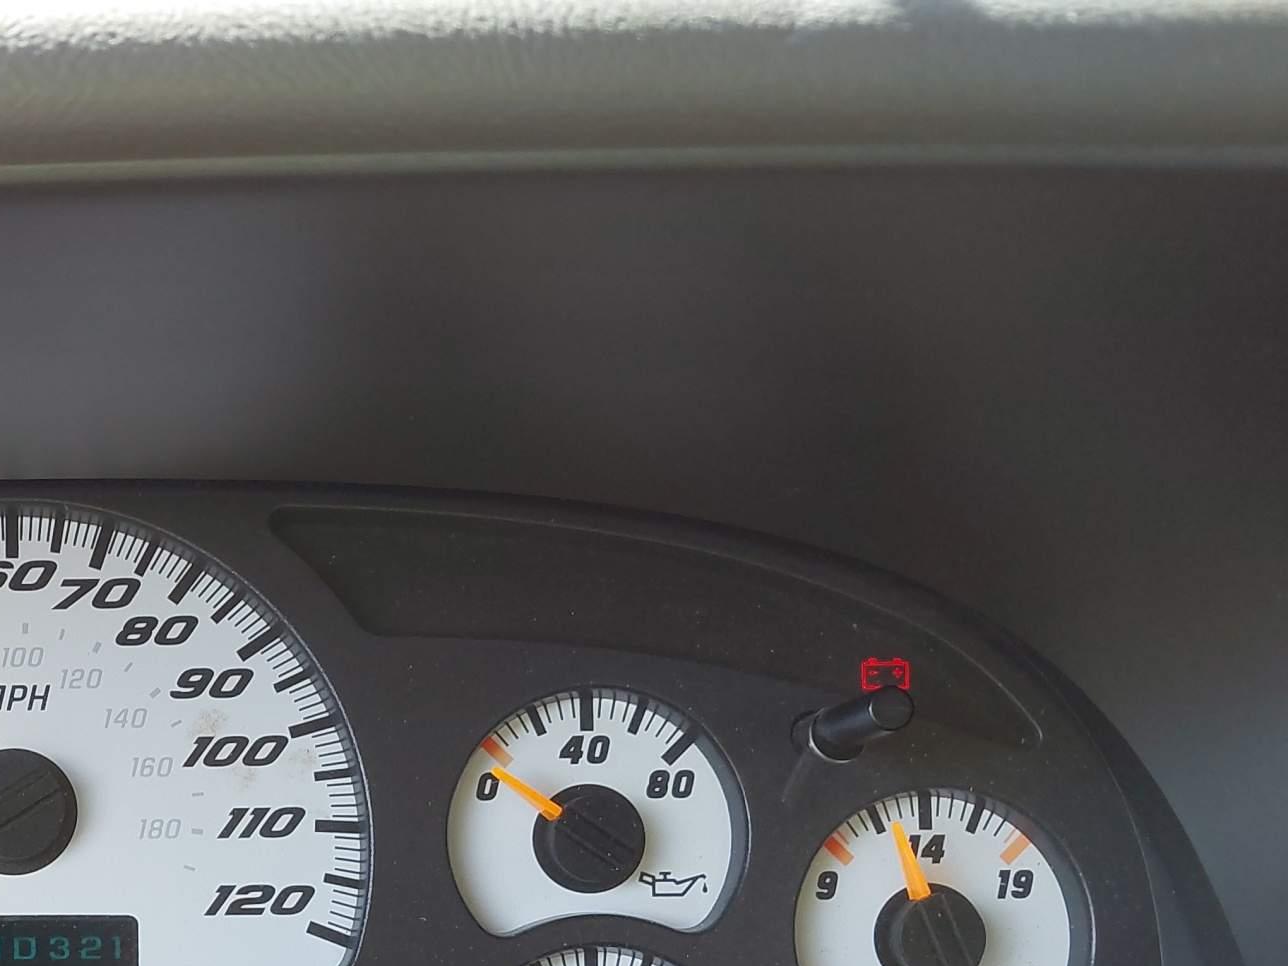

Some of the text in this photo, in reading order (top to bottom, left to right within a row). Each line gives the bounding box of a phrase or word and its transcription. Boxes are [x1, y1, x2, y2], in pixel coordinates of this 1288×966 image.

[54, 578, 141, 609] 70
[116, 616, 198, 646] 80
[3, 647, 43, 667] 100
[61, 669, 102, 688] 120
[170, 668, 253, 699] 90
[105, 708, 147, 728] 140
[183, 736, 288, 767] 100
[559, 736, 610, 764] 40
[132, 757, 173, 777] 160
[476, 773, 499, 801] 0
[647, 770, 694, 798] 80
[140, 819, 181, 839] 180
[218, 807, 305, 838] 110
[816, 871, 838, 900] 9
[998, 870, 1033, 899] 19
[205, 885, 315, 915] 120
